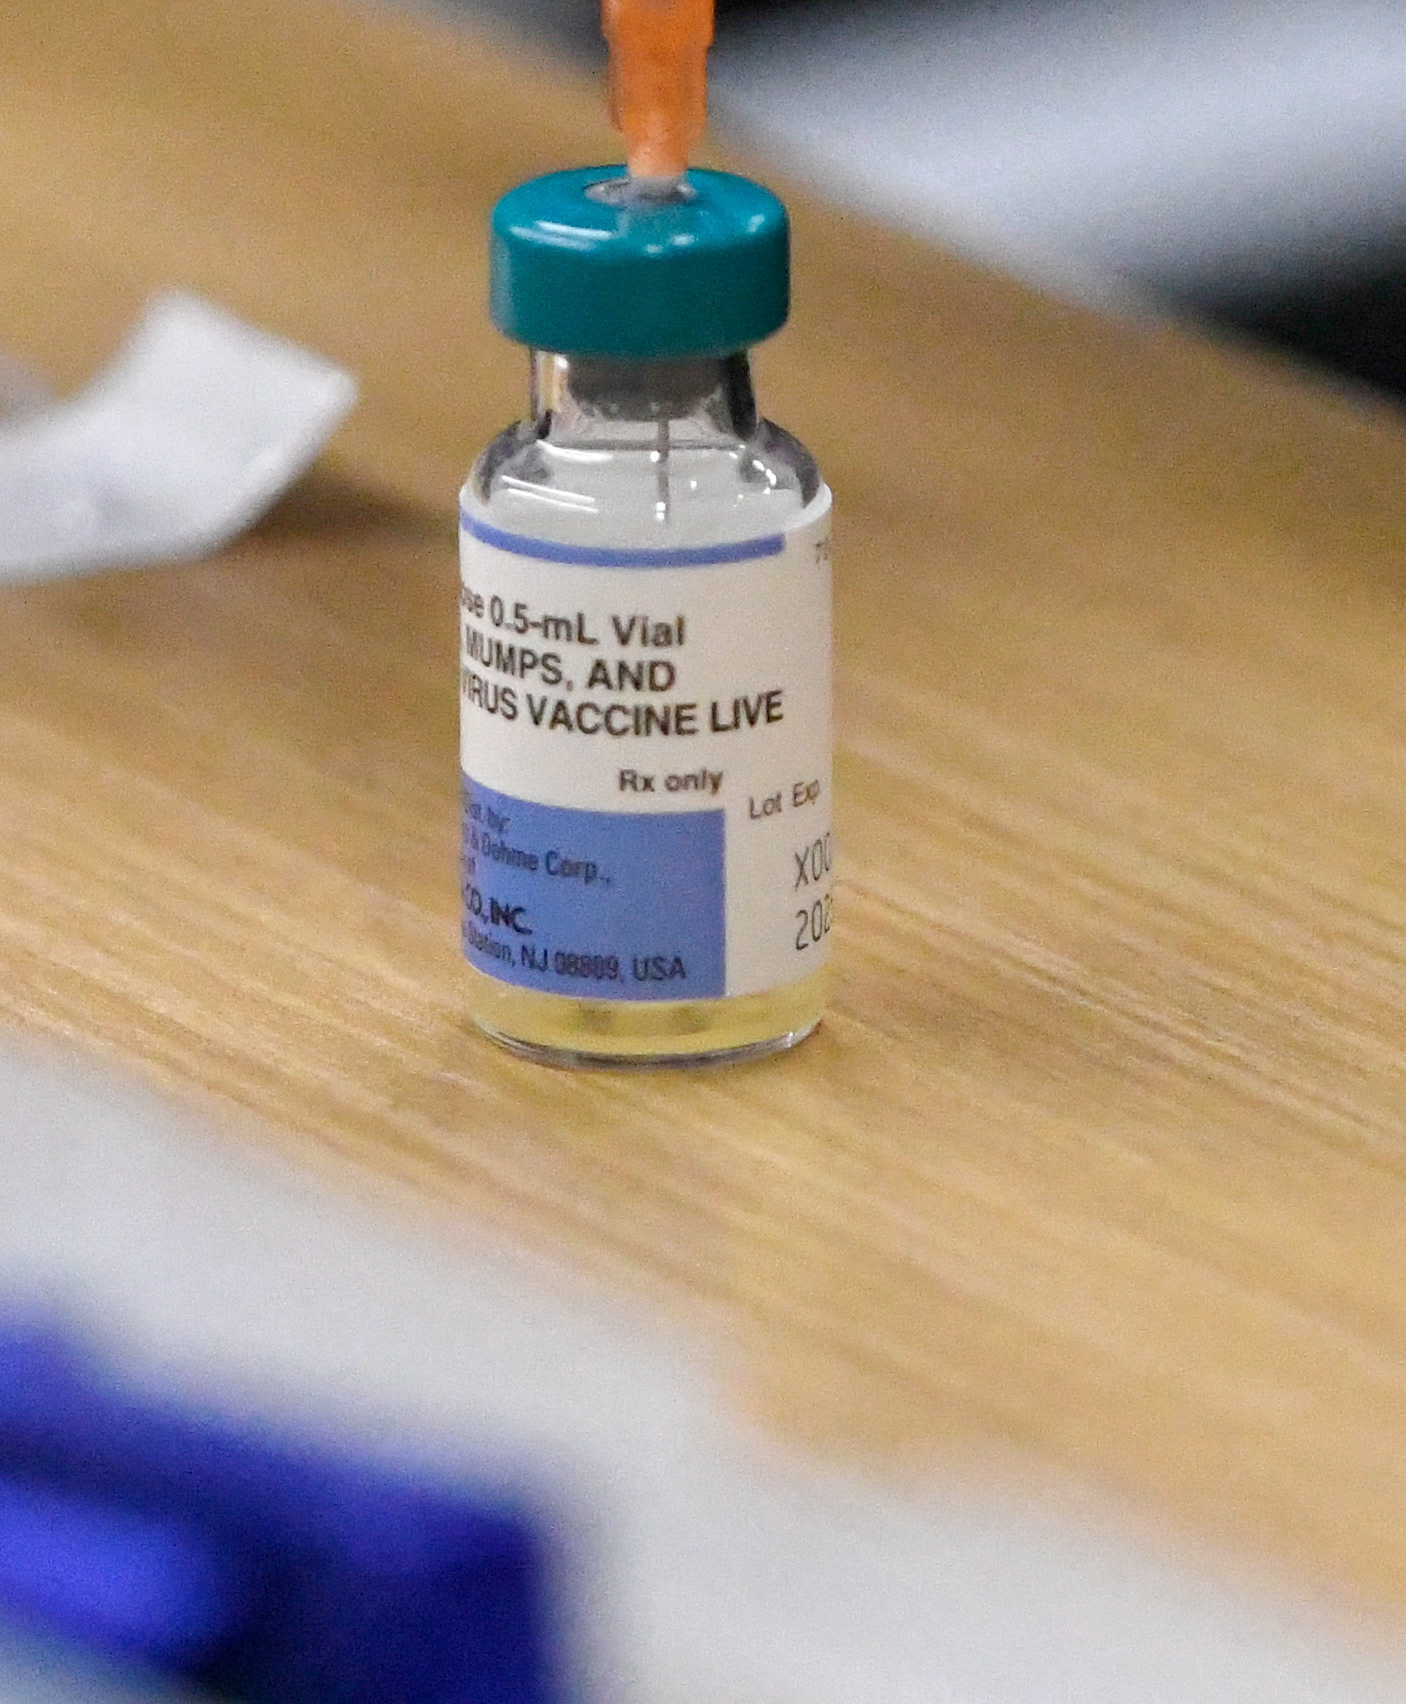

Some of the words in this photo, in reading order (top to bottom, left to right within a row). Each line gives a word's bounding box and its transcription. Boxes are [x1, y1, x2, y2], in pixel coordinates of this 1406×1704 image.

[489, 594, 601, 646] 0.5-mL
[610, 612, 686, 647] Vial
[465, 623, 574, 692] MUMPS,
[586, 657, 677, 693] AND
[524, 692, 698, 737] VACCINE
[709, 689, 785, 734] LIVE
[618, 767, 657, 794] Rx
[664, 767, 725, 796] only
[748, 791, 784, 820] Lot
[520, 944, 550, 973] NJ
[632, 954, 688, 983] USA
